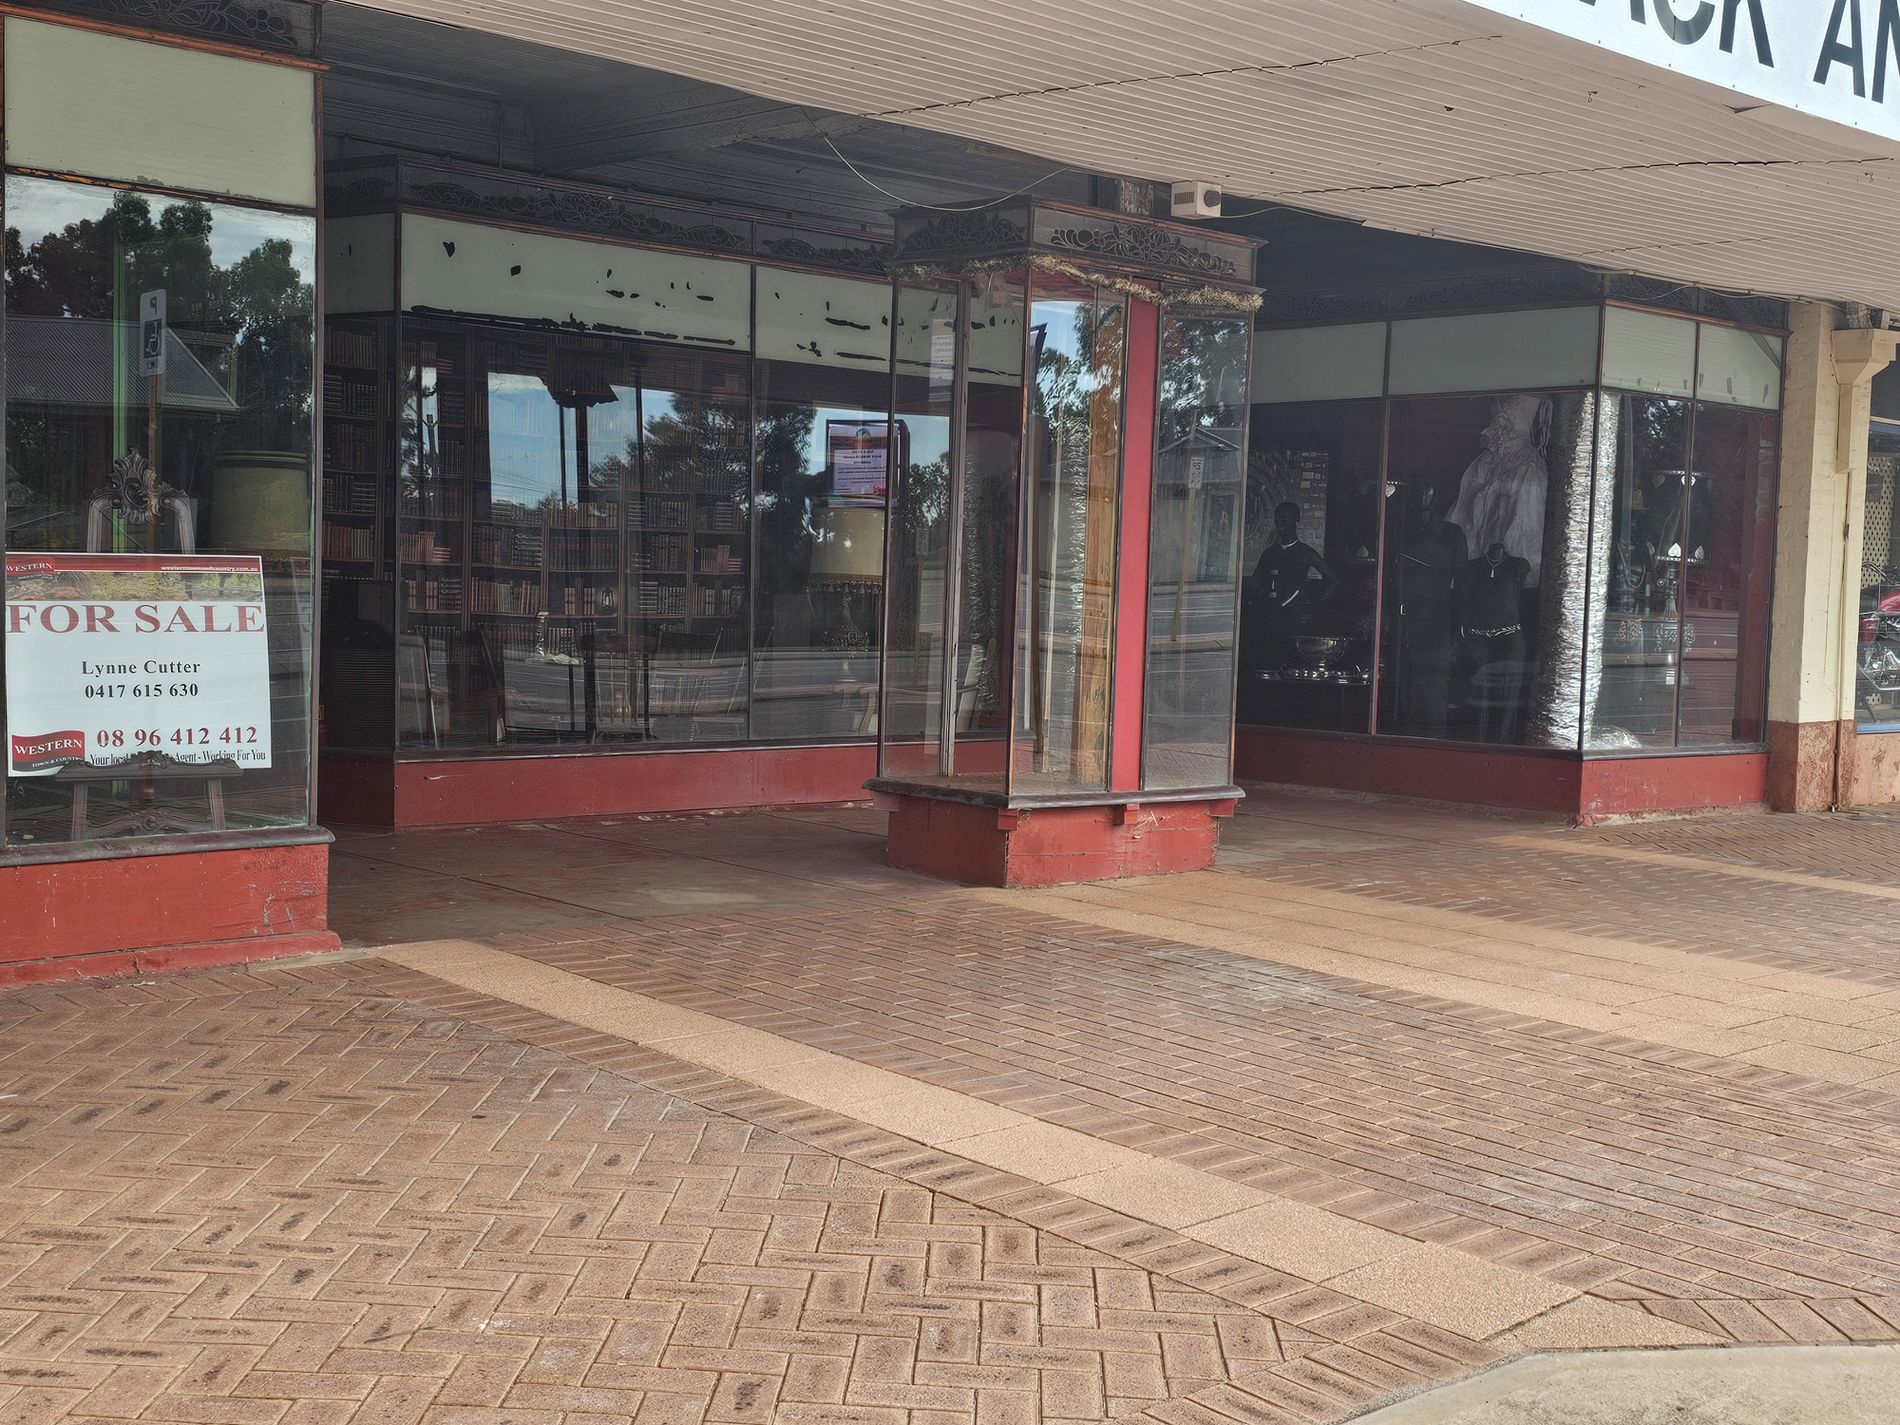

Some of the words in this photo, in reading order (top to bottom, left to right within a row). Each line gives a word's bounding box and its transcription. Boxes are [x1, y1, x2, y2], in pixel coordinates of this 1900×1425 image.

[6, 562, 53, 572] WESTERN
[6, 604, 120, 633] FOR
[134, 604, 265, 633] SALE
[81, 660, 137, 677] Lynne
[143, 659, 201, 674] Cutter
[85, 683, 126, 698] 0417
[133, 683, 163, 697] 615
[169, 682, 199, 697] 630
[96, 729, 125, 748] 08
[134, 728, 161, 747] 96
[170, 727, 210, 745] 412
[219, 726, 258, 744] 412
[14, 738, 83, 755] WESTERN
[31, 760, 49, 768] TOWN
[90, 753, 109, 765] Your
[237, 749, 250, 761] For
[251, 749, 266, 761] You
